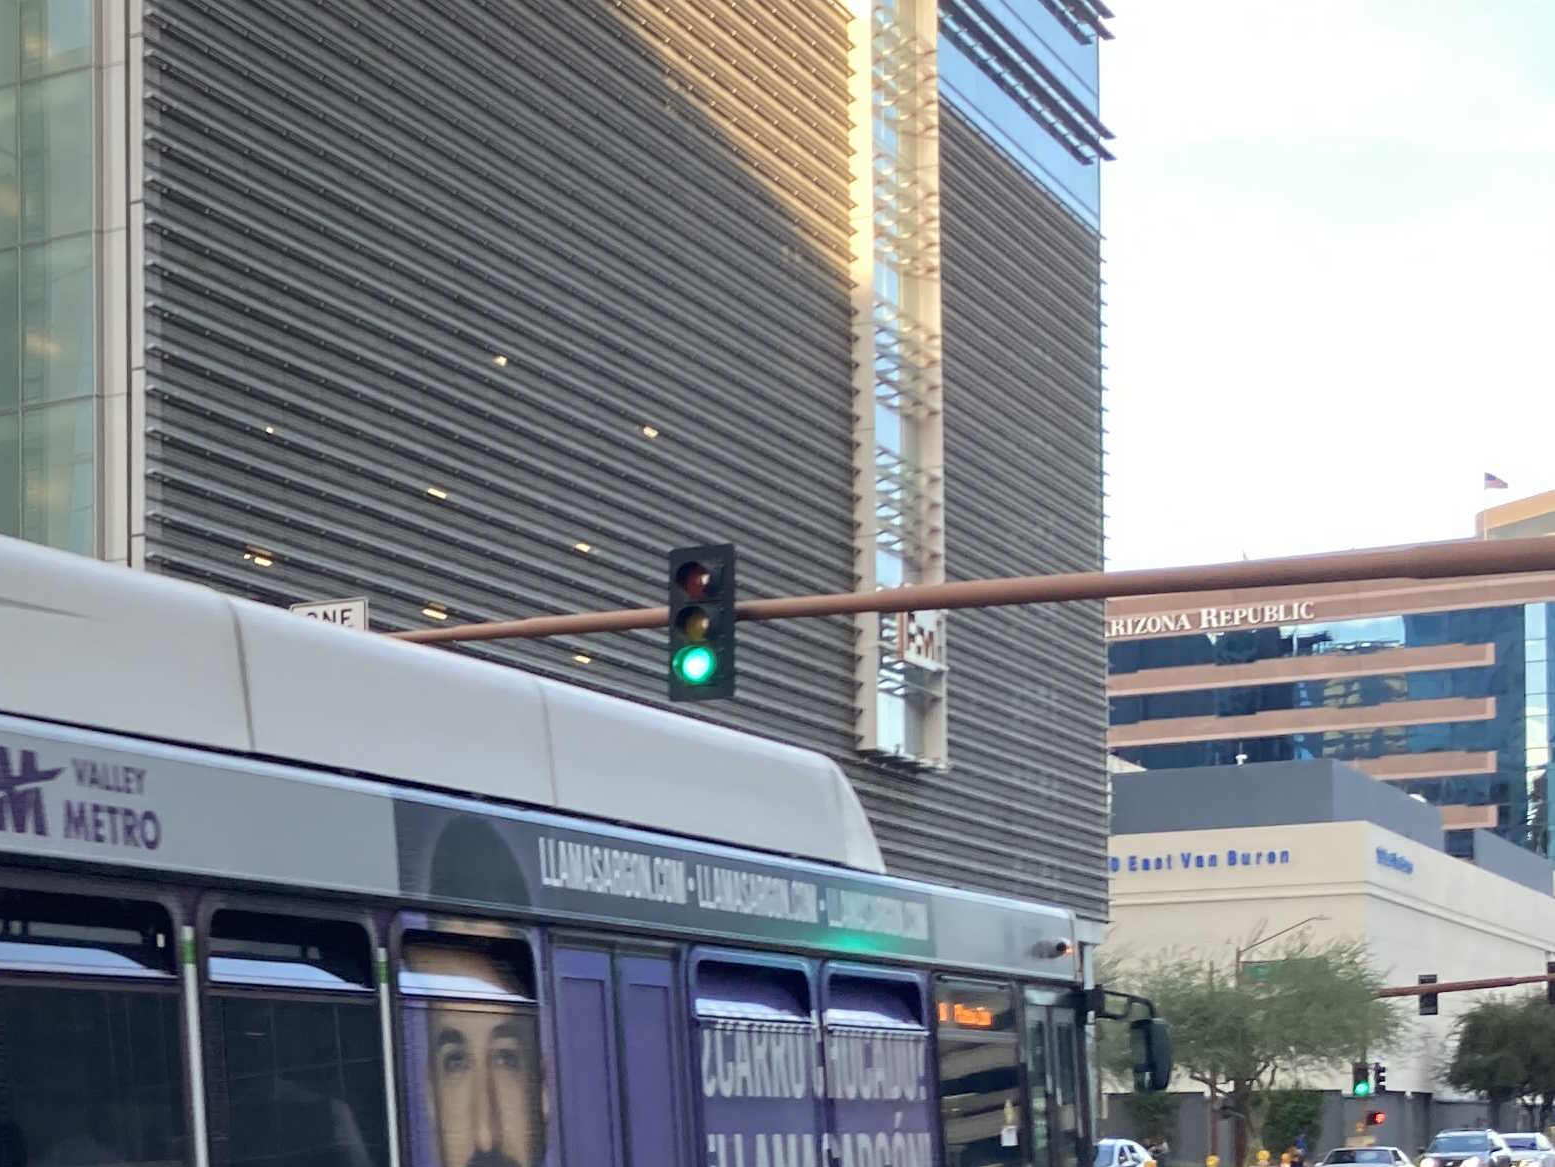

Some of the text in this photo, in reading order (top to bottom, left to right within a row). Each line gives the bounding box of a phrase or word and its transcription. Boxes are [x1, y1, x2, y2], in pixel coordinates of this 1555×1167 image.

[1200, 601, 1315, 629] REPUBLIC
[72, 757, 147, 795] VALLEY
[62, 799, 162, 850] METRO
[1128, 854, 1172, 872] East
[1181, 852, 1218, 869] Van
[1227, 849, 1290, 867] Buren
